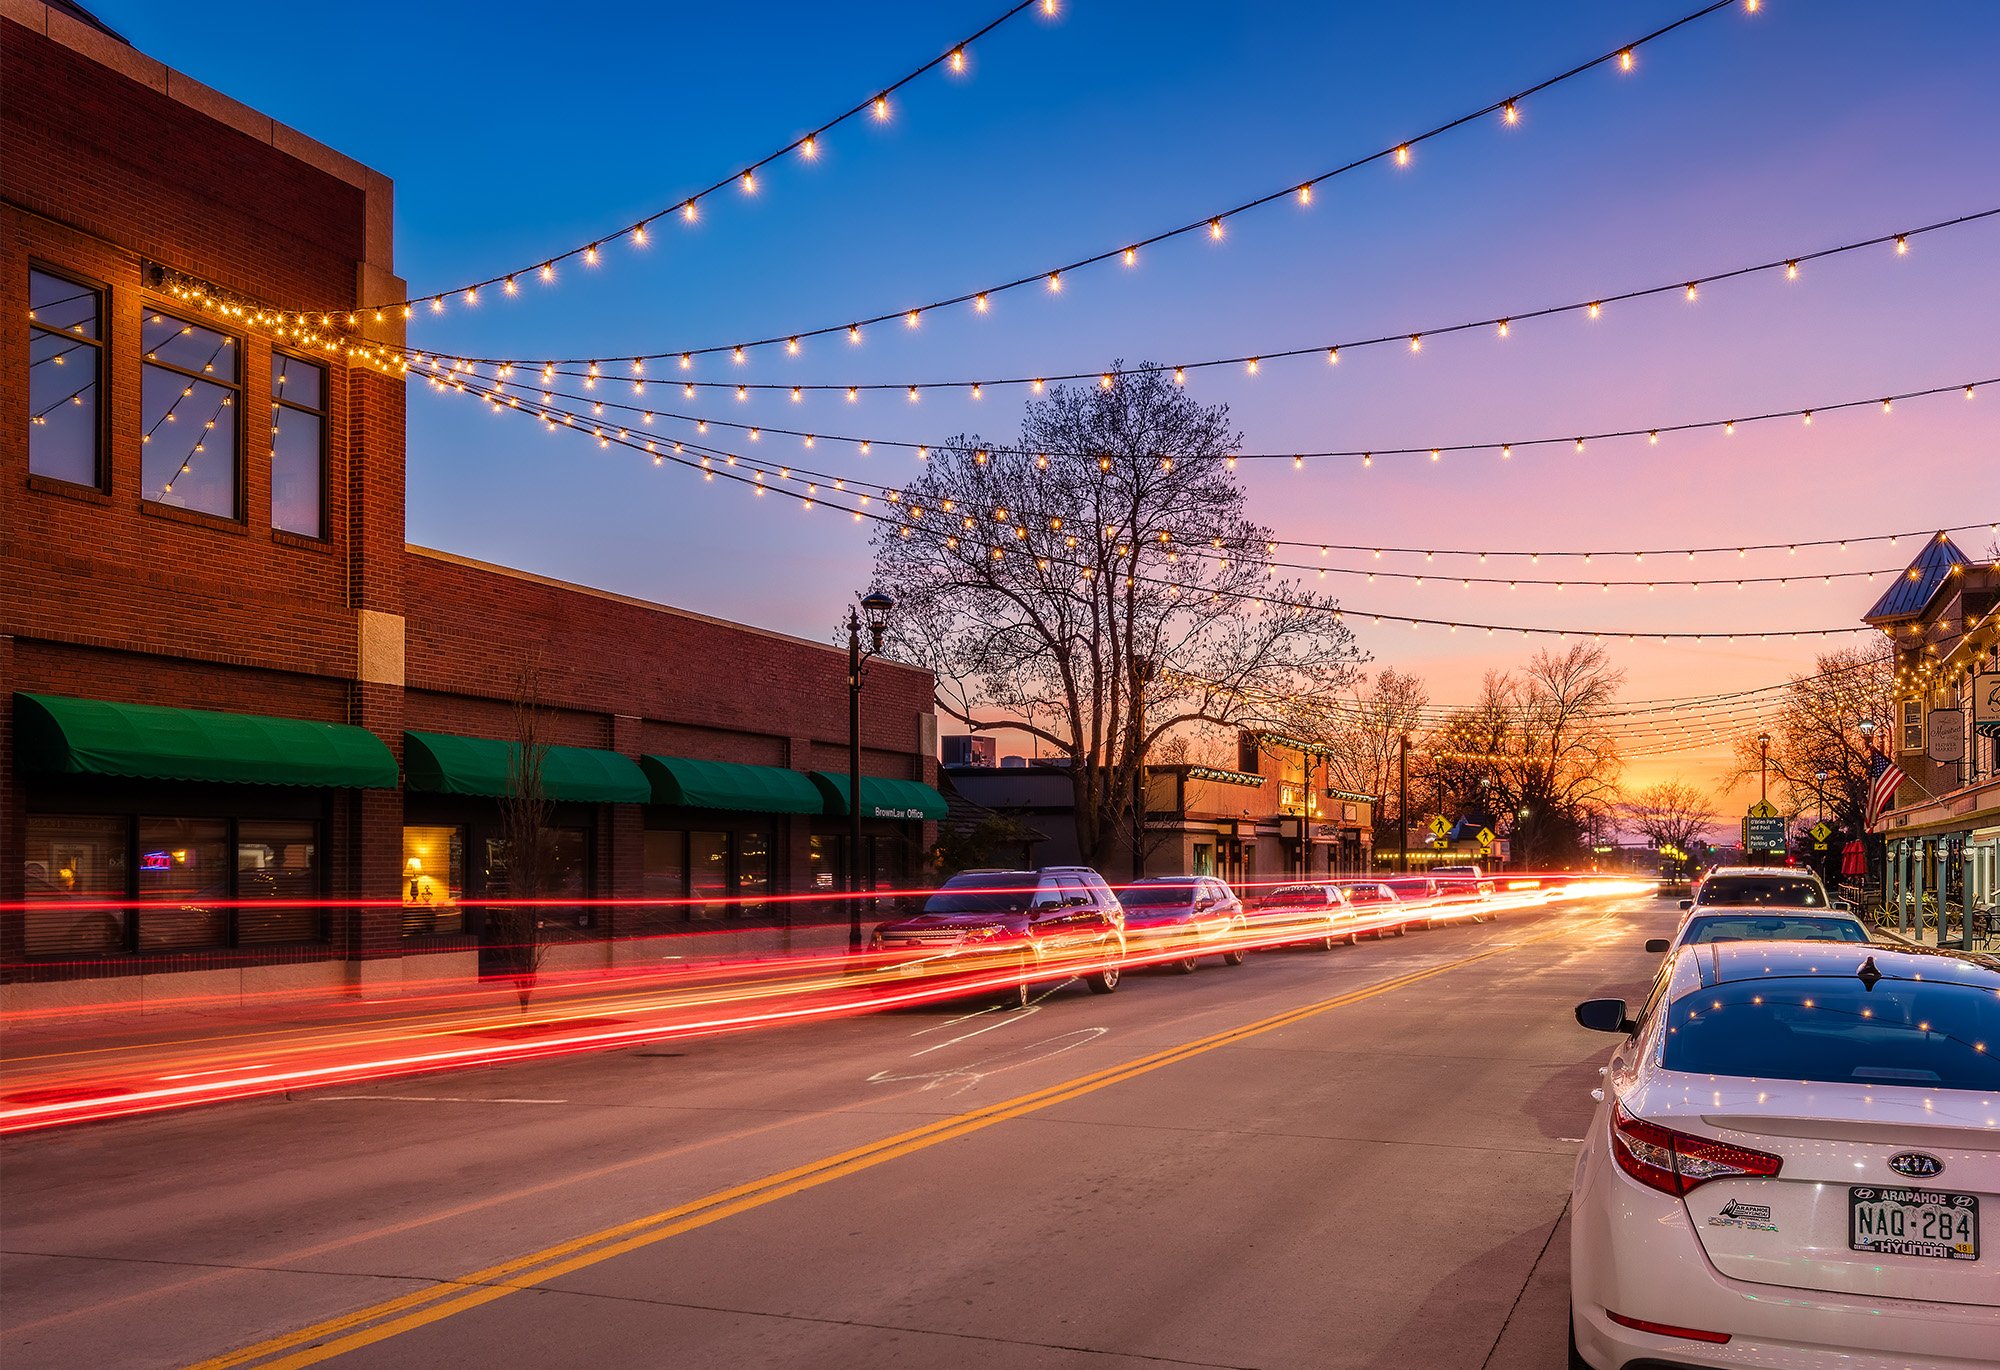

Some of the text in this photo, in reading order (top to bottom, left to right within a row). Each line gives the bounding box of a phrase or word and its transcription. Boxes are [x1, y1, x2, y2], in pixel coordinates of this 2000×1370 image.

[907, 808, 924, 819] Office
[1900, 1158, 1935, 1173] KIA
[1880, 1190, 1947, 1205] ARAPAHOE
[1736, 1205, 1768, 1213] ARAPAHOE
[1880, 1241, 1948, 1258] HYUNDAI
[1958, 1244, 1968, 1252] 18
[1953, 1252, 1976, 1260] COLORADO
